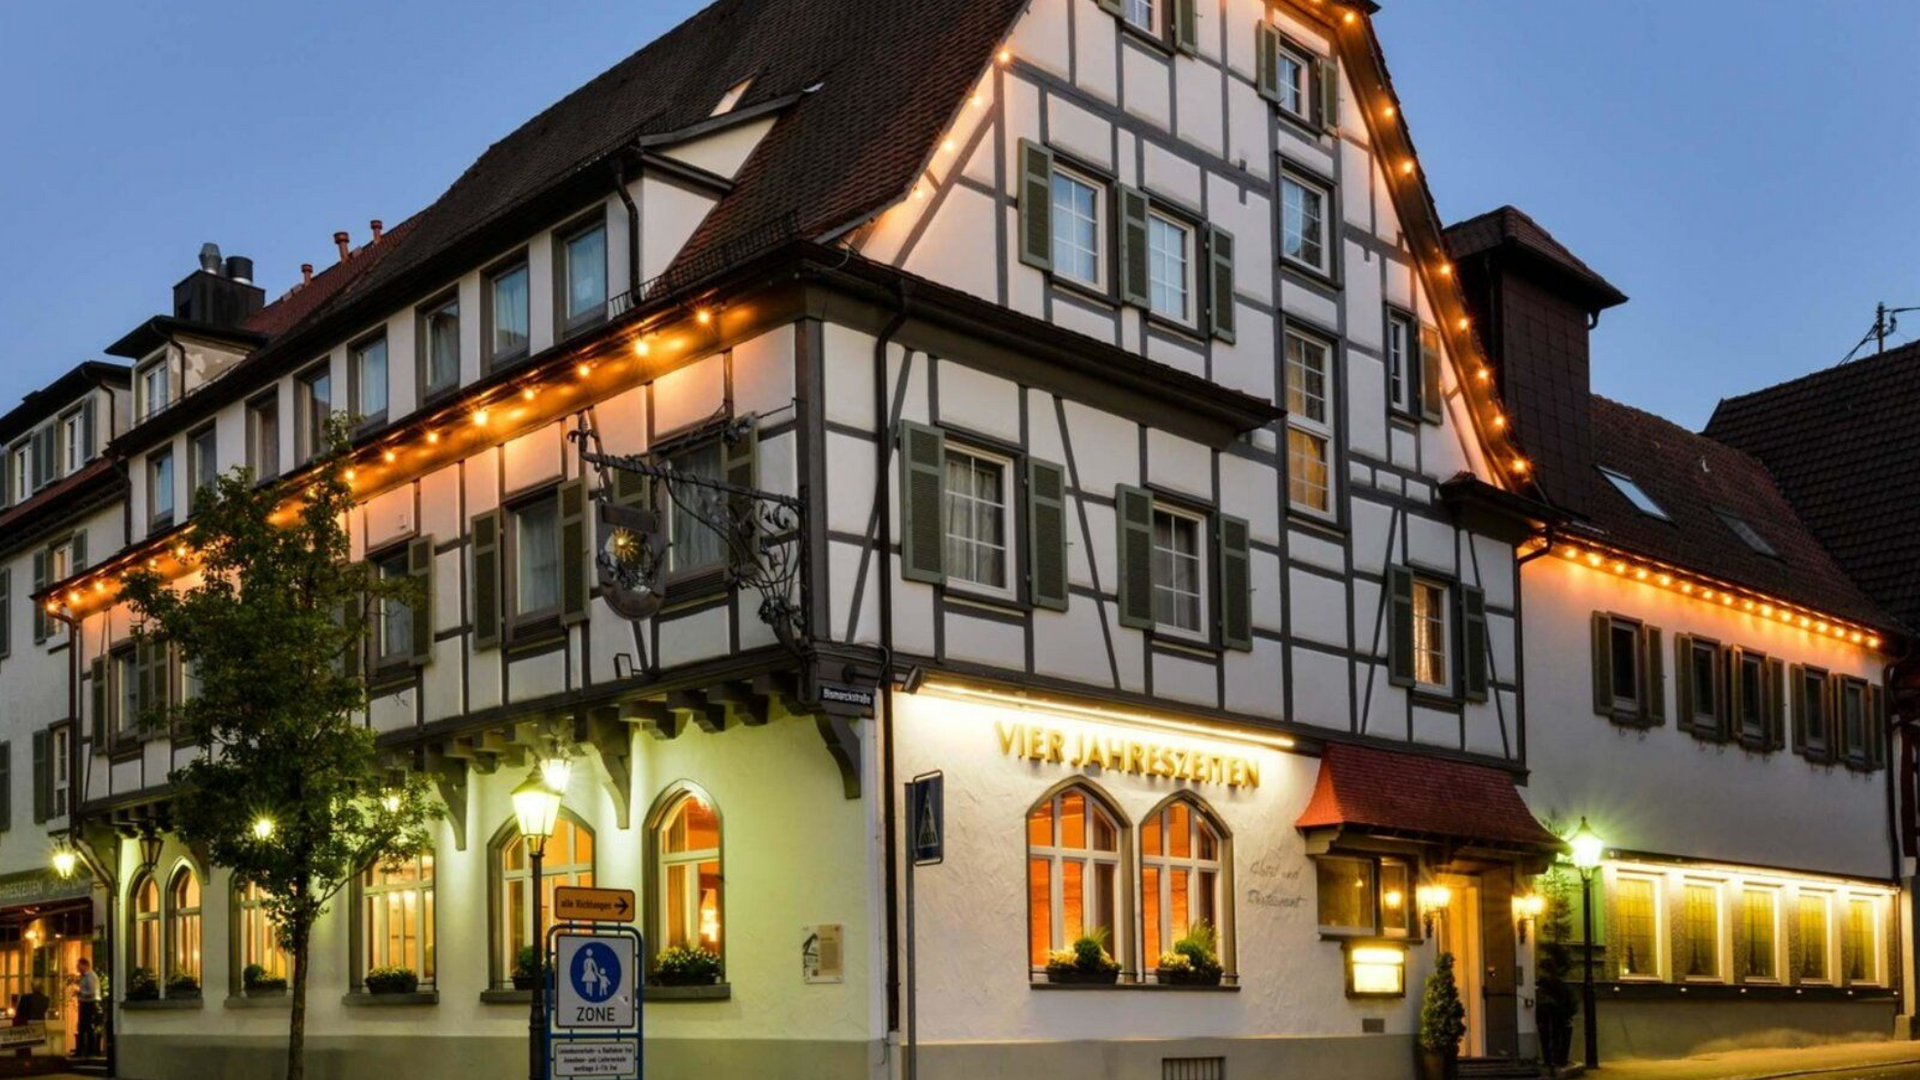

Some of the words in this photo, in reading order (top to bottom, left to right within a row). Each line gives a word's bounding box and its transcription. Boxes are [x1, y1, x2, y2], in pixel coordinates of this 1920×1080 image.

[995, 721, 1064, 764] VIER
[1070, 733, 1260, 788] JAHRESZEITEN
[576, 899, 612, 911] Richtungen
[576, 1007, 616, 1022] ZONE
